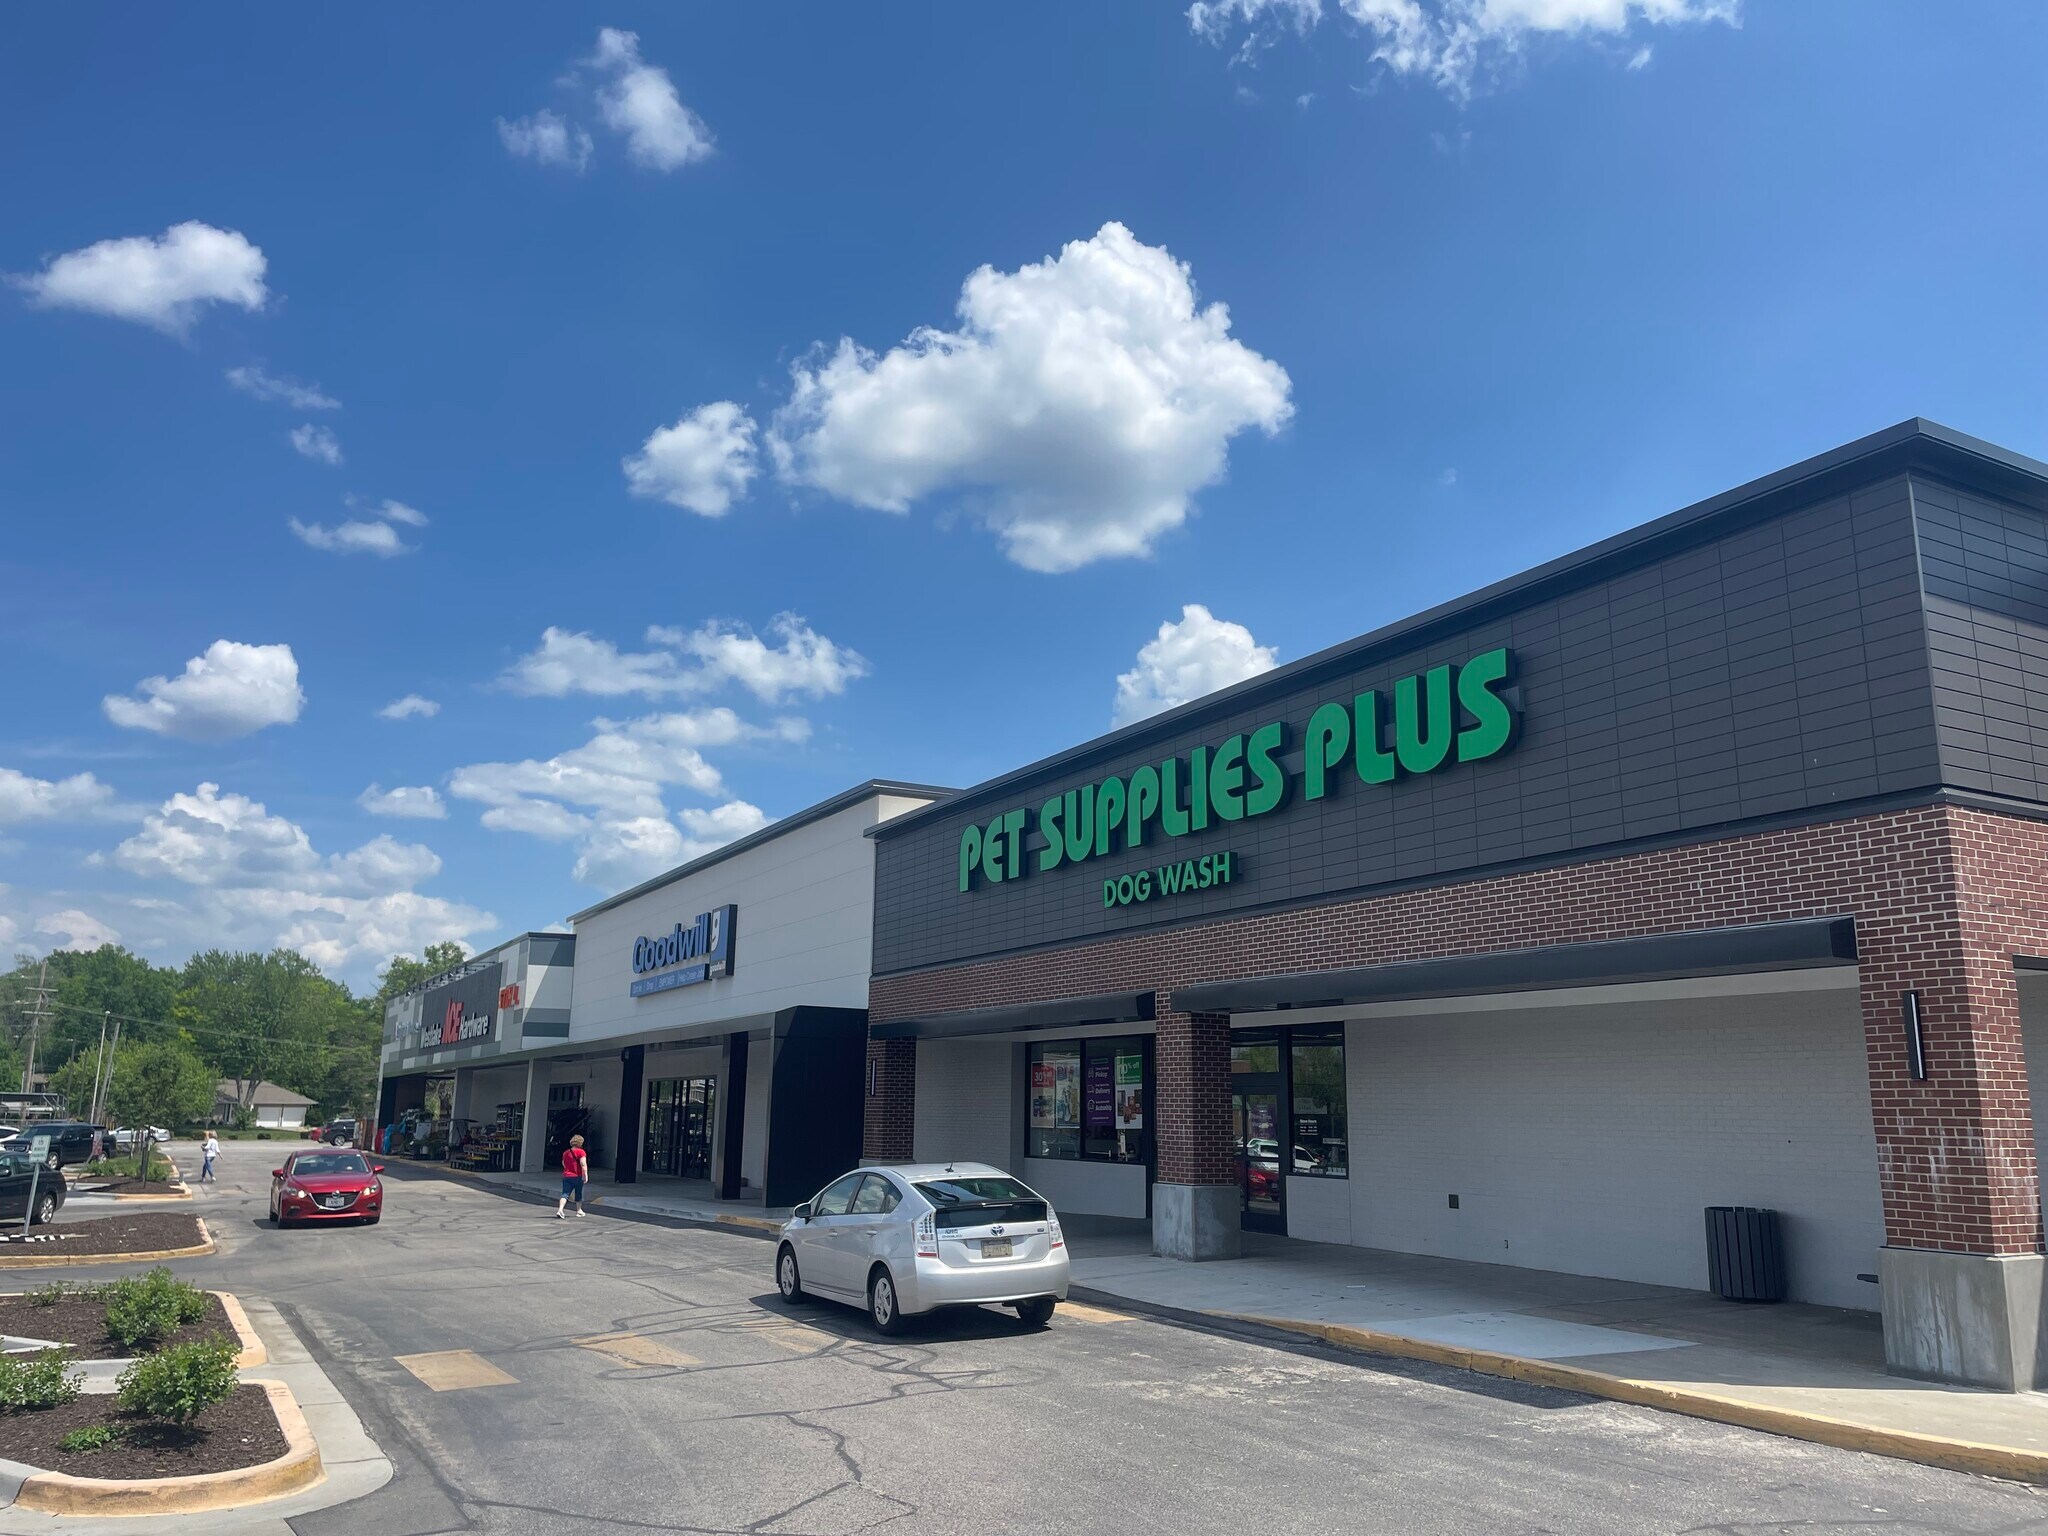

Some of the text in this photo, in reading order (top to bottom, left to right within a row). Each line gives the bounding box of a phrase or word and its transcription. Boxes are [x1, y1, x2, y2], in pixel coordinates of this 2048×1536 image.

[959, 647, 1514, 893] PET SUPPLIES PLUS
[1104, 852, 1232, 909] DOG WASH
[633, 912, 711, 974] Goodwill
[421, 1024, 442, 1048] Westlake
[442, 998, 463, 1044] ACE
[459, 1012, 489, 1040] Hardware
